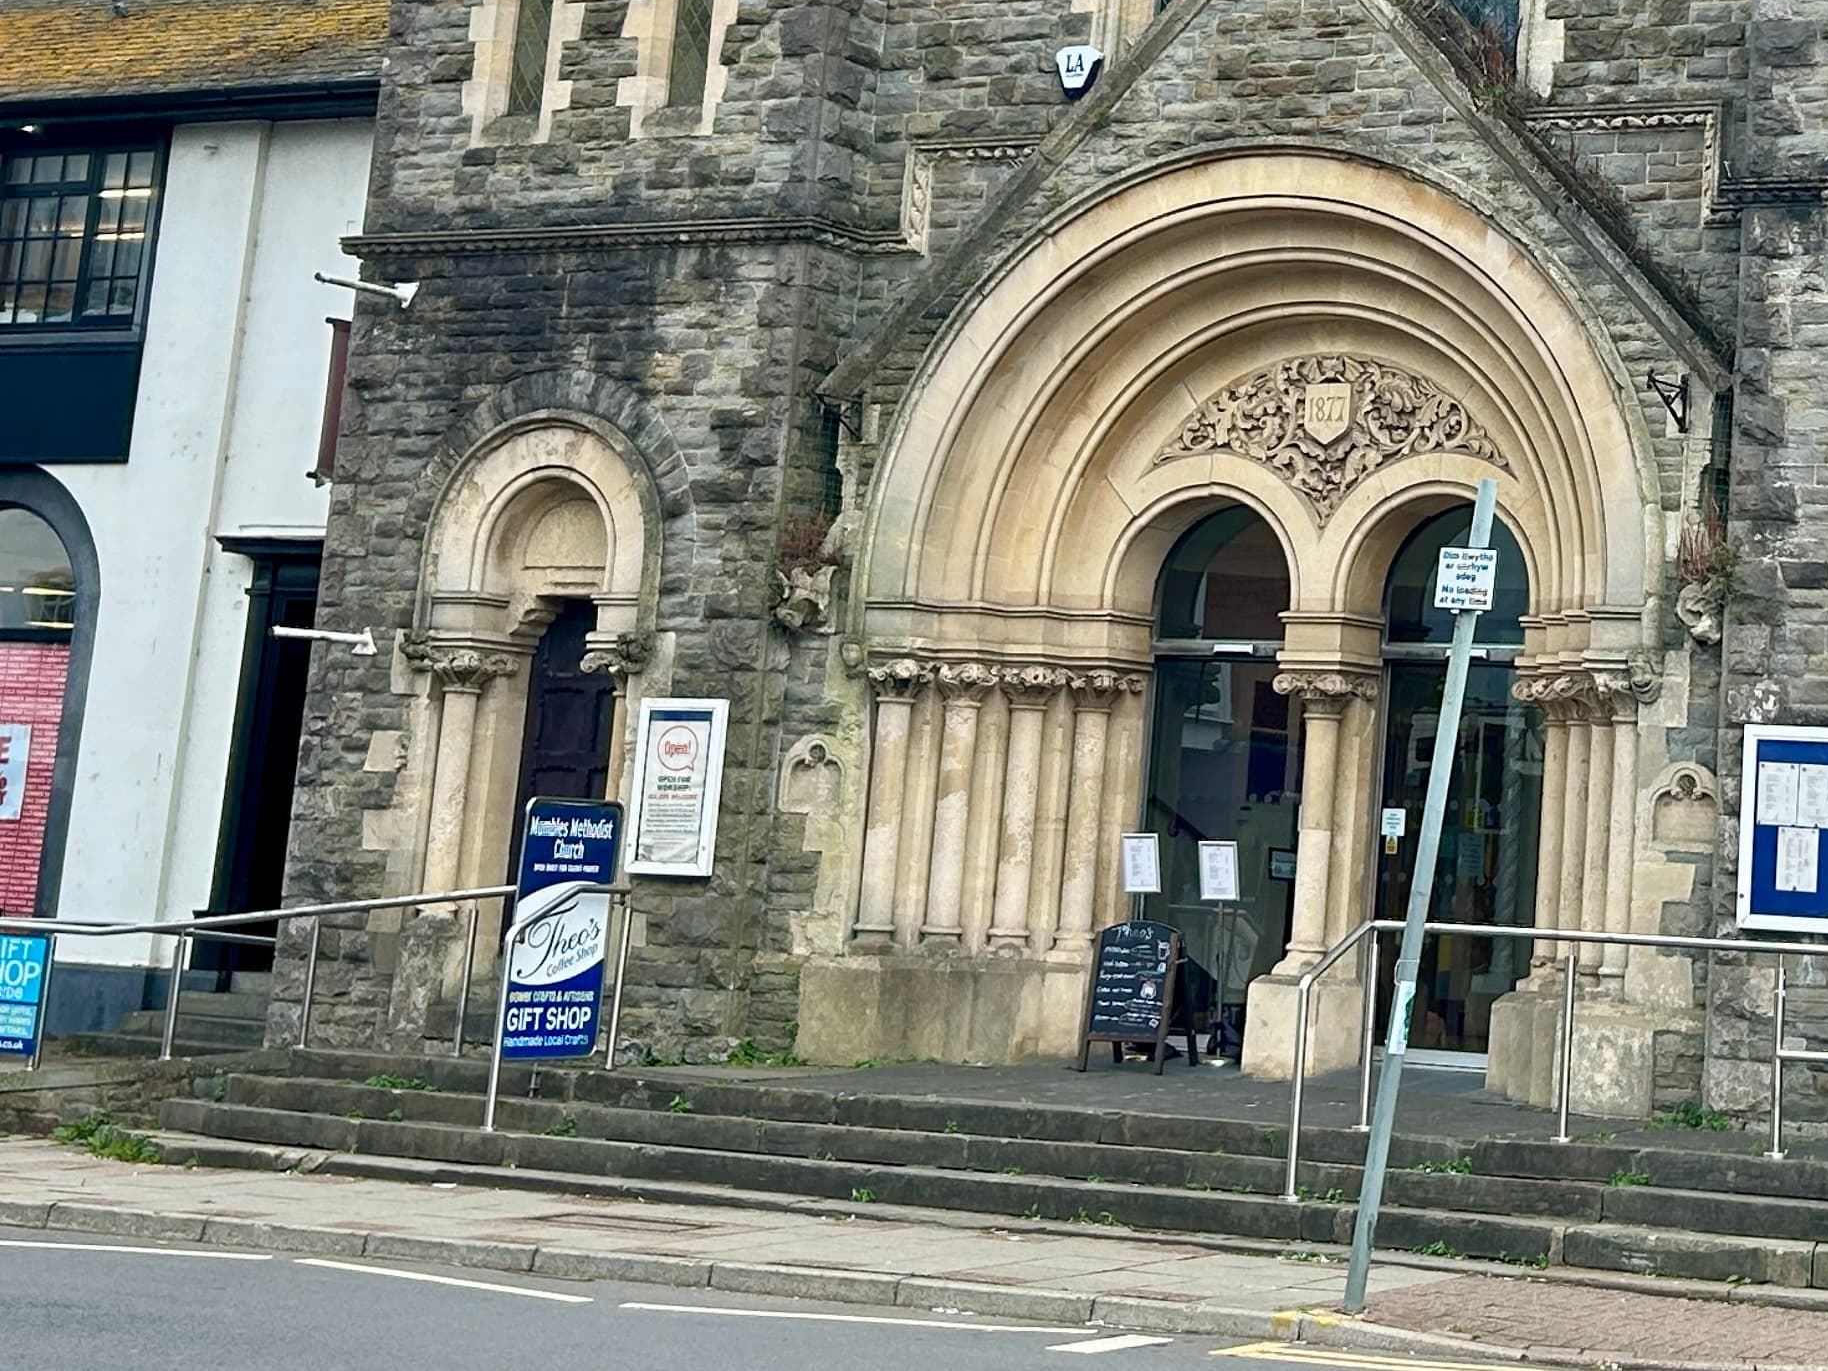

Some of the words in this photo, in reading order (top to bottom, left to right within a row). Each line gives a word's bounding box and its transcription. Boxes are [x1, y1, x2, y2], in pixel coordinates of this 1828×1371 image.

[1308, 396, 1346, 423] 1877
[1442, 584, 1454, 594] No
[664, 739, 691, 757] Open!
[529, 815, 569, 837] Mumbles
[570, 817, 613, 839] Methodist
[554, 838, 585, 859] Church
[0, 937, 33, 960] IFT
[516, 900, 602, 980] Theo's
[546, 955, 575, 977] Coffee
[576, 943, 598, 963] Shop
[0, 959, 41, 987] OP
[506, 1007, 544, 1032] GIFT
[545, 1006, 592, 1031] SHOP
[502, 1035, 543, 1047] Handmade
[544, 1034, 564, 1046] Local
[564, 1034, 589, 1046] Crafts
